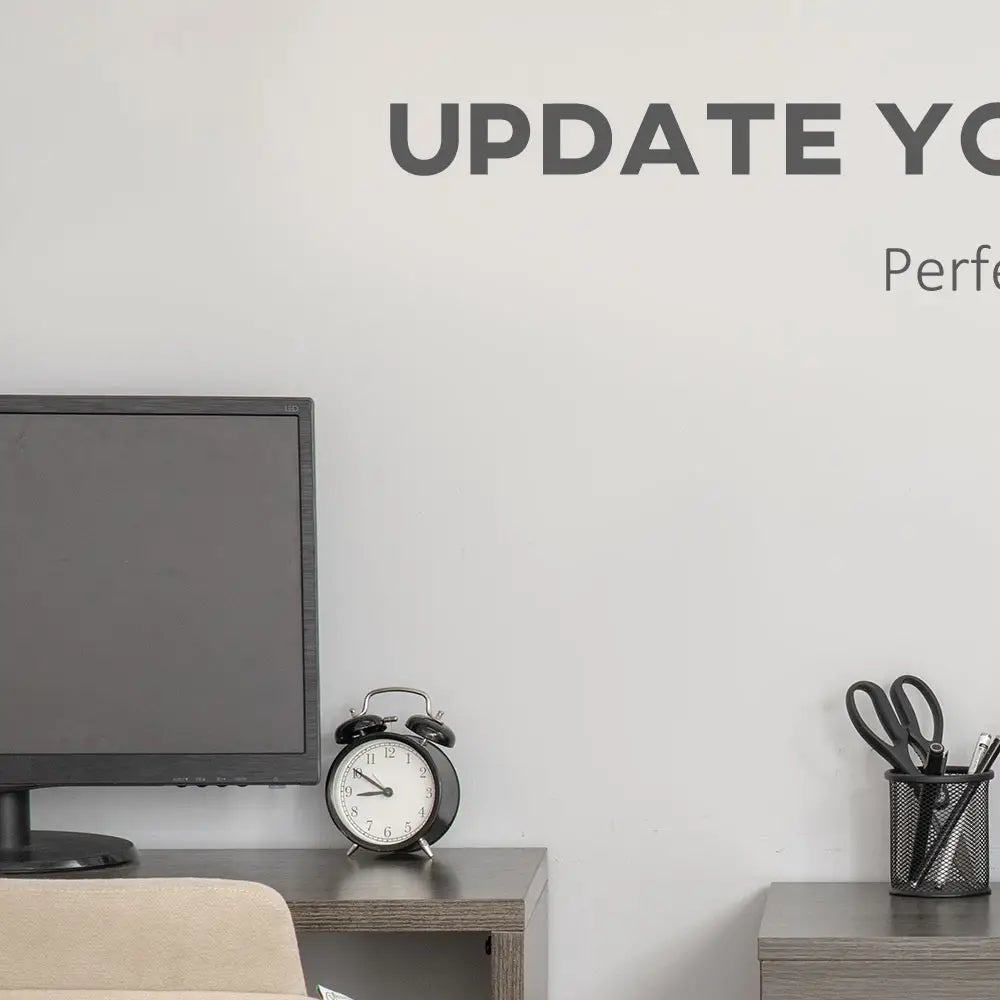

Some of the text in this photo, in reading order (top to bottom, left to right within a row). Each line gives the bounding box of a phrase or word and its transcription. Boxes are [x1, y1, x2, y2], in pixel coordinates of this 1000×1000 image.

[384, 747, 396, 758] 12
[366, 753, 375, 764] 11
[406, 753, 411, 764] 1
[419, 767, 427, 778] 2
[344, 786, 353, 798] 9
[425, 787, 433, 799] 3
[350, 806, 359, 817] 8
[418, 806, 426, 818] 4
[366, 820, 374, 832] 7
[404, 822, 412, 833] 5
[383, 826, 392, 838] 6
